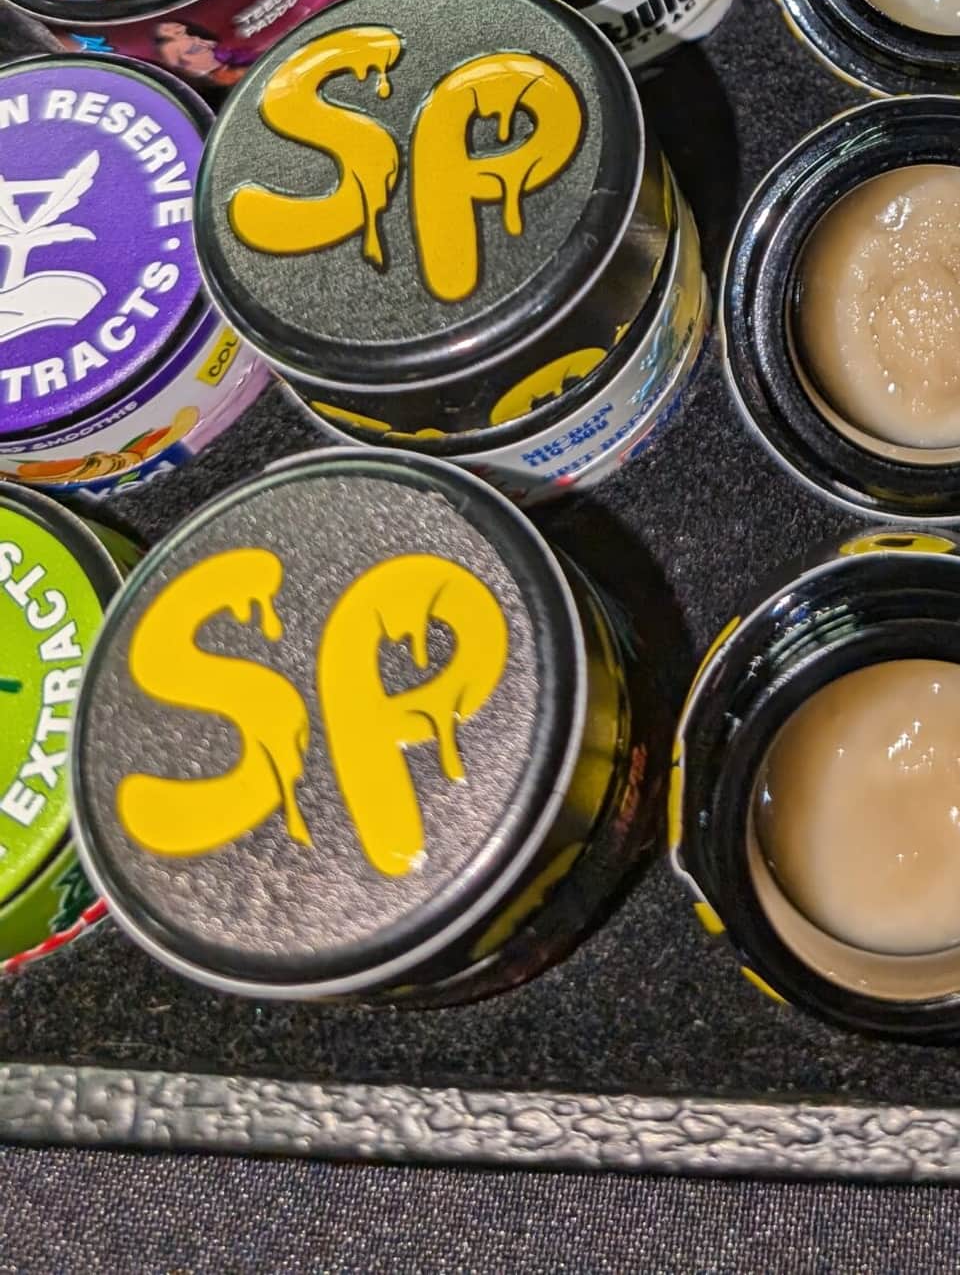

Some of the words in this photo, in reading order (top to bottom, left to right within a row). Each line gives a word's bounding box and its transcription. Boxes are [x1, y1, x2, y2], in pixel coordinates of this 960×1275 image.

[44, 89, 192, 227] RESERVE
[227, 25, 588, 303] SP
[0, 540, 83, 826] EXTRACTS
[116, 546, 508, 877] SP
